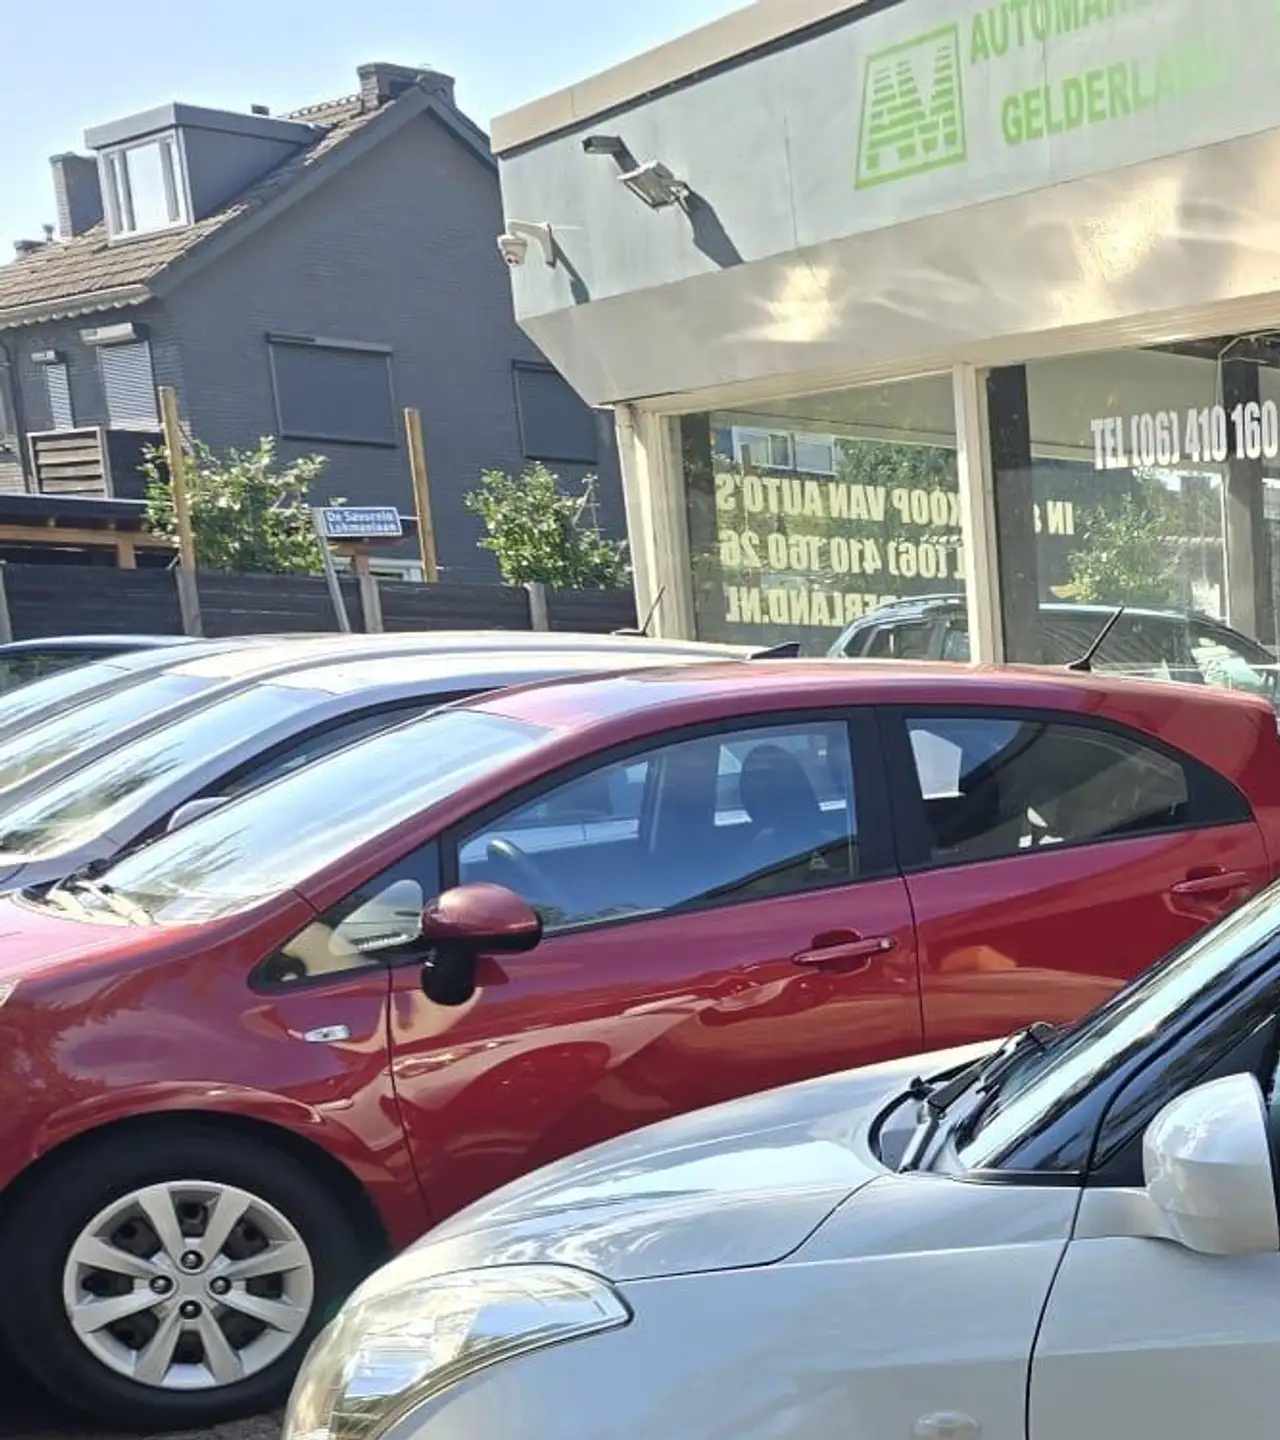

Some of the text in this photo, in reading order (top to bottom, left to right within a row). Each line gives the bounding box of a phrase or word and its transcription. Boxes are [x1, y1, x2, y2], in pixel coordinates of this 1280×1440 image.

[1090, 416, 1128, 470] TEL
[1131, 411, 1180, 467] (06)
[1185, 405, 1228, 463] 410
[1231, 400, 1278, 460] 160
